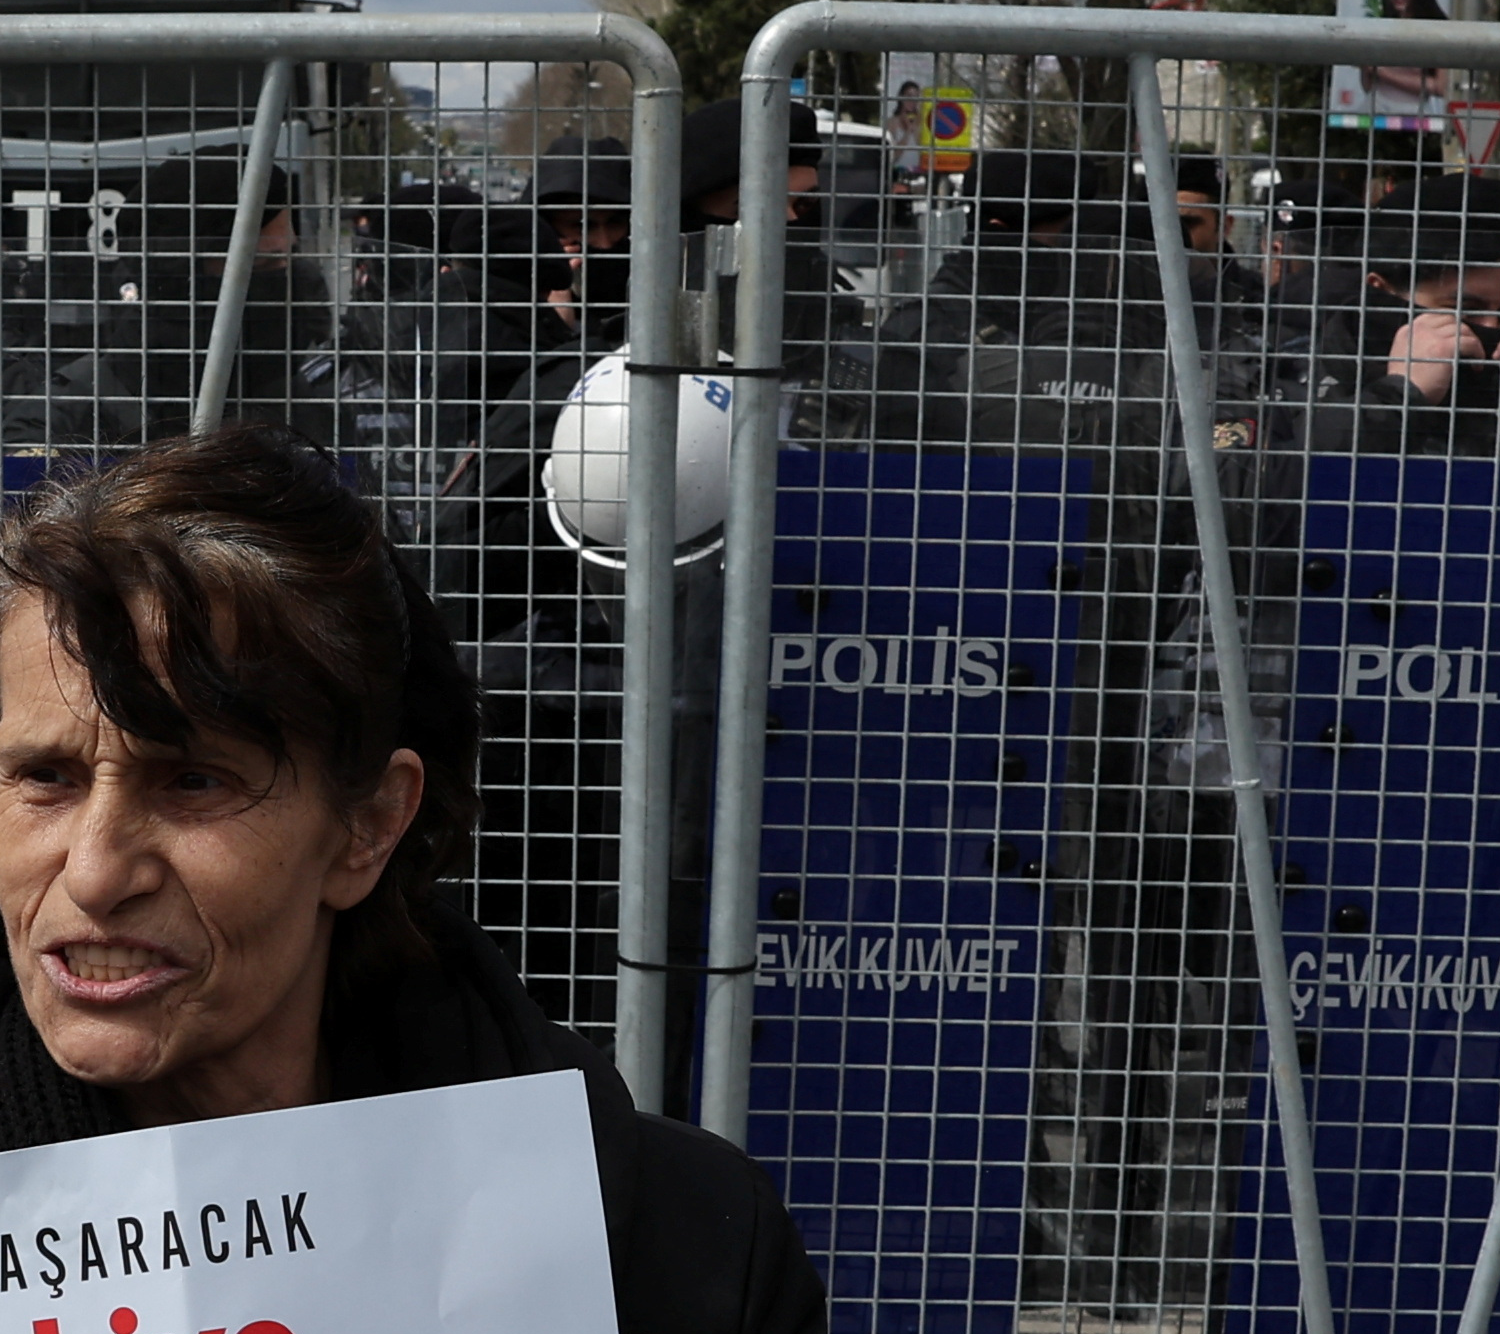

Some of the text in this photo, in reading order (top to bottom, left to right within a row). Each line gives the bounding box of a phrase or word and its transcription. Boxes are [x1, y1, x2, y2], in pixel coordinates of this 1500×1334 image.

[769, 626, 1000, 697] POLİS
[753, 925, 1019, 993] EVİK KUVVET
[1289, 939, 1410, 1020] ÇEVİK
